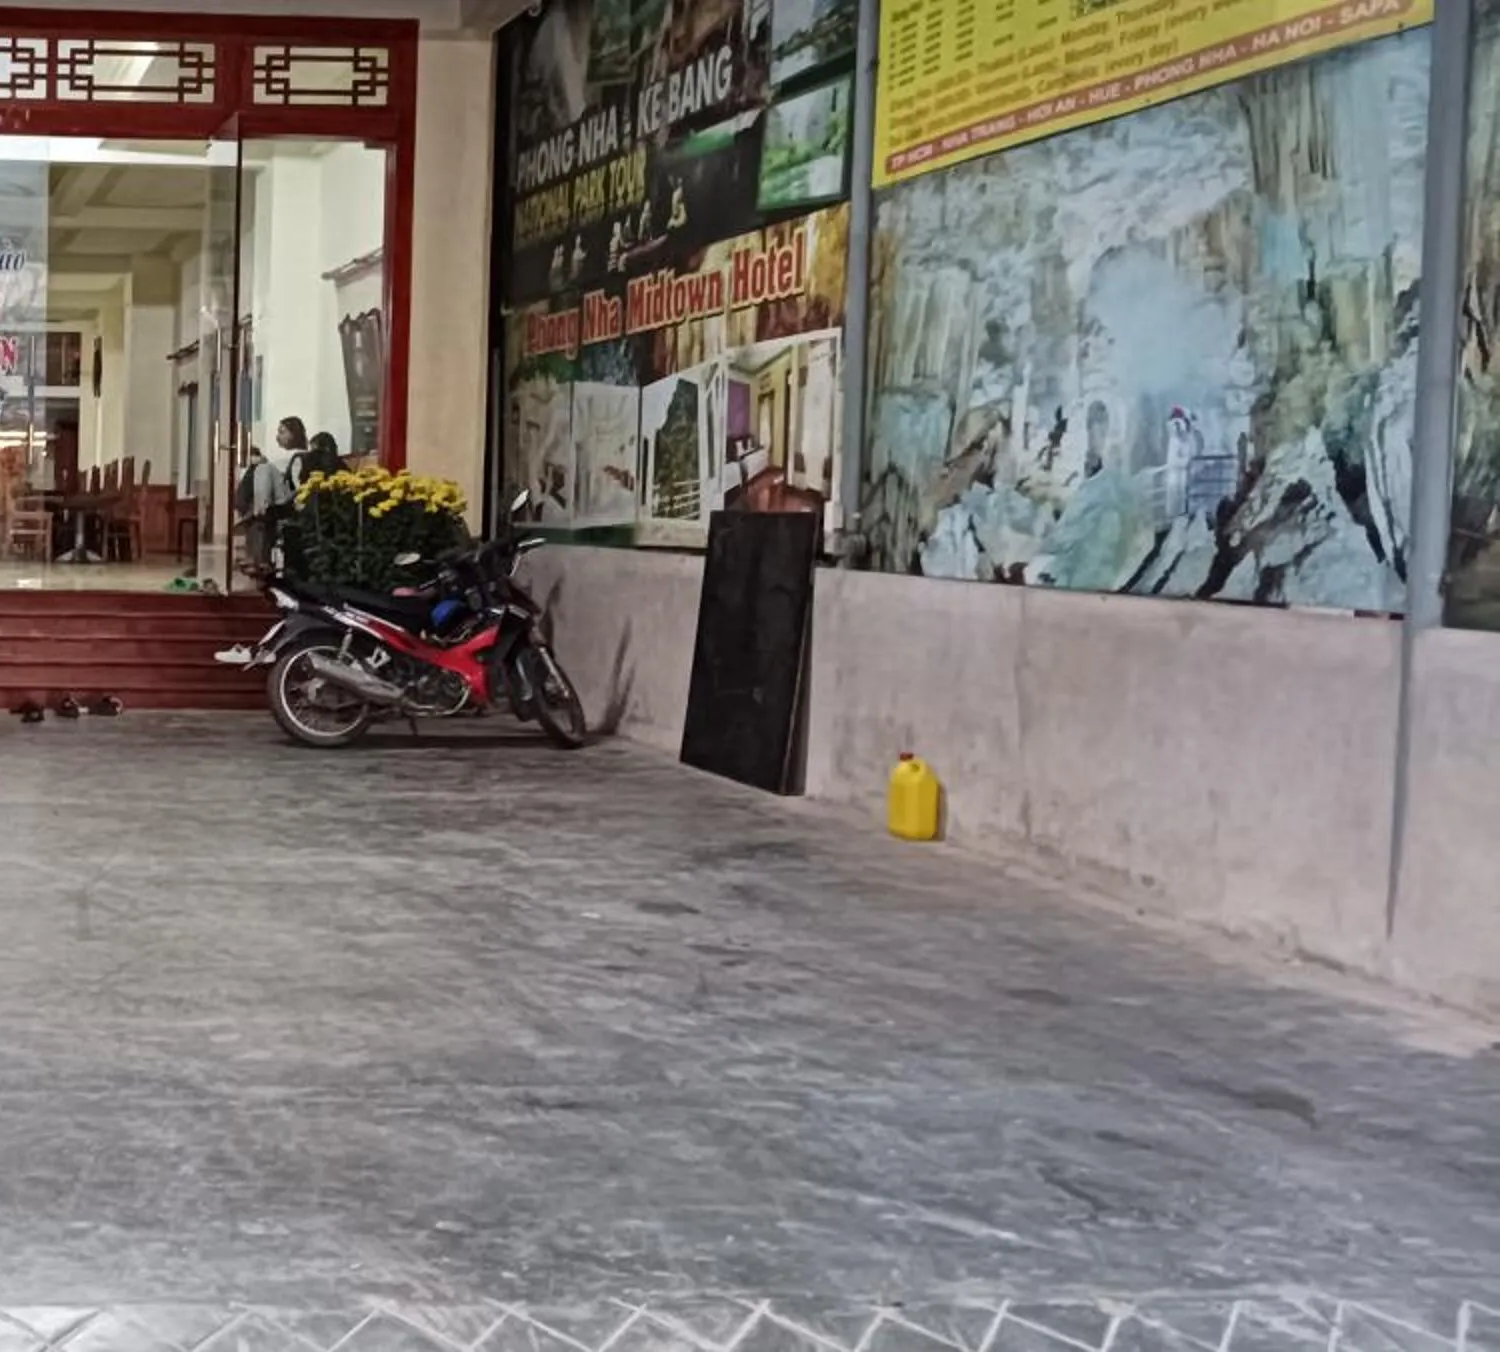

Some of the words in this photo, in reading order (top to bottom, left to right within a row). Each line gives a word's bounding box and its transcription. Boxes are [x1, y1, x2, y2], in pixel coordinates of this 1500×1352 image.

[1088, 82, 1121, 104] HUE
[1134, 57, 1195, 91] PHONG
[1198, 44, 1237, 69] NHA
[1252, 30, 1280, 50] HA
[1283, 16, 1322, 39] NOI
[1339, 0, 1399, 24] SAPA
[516, 127, 575, 193] PHONG
[578, 104, 618, 167] NHA
[667, 44, 733, 125] BANG
[526, 308, 579, 358] Phong
[582, 291, 621, 343] Nha
[626, 267, 722, 335] Midtown
[731, 229, 805, 303] Hotel
